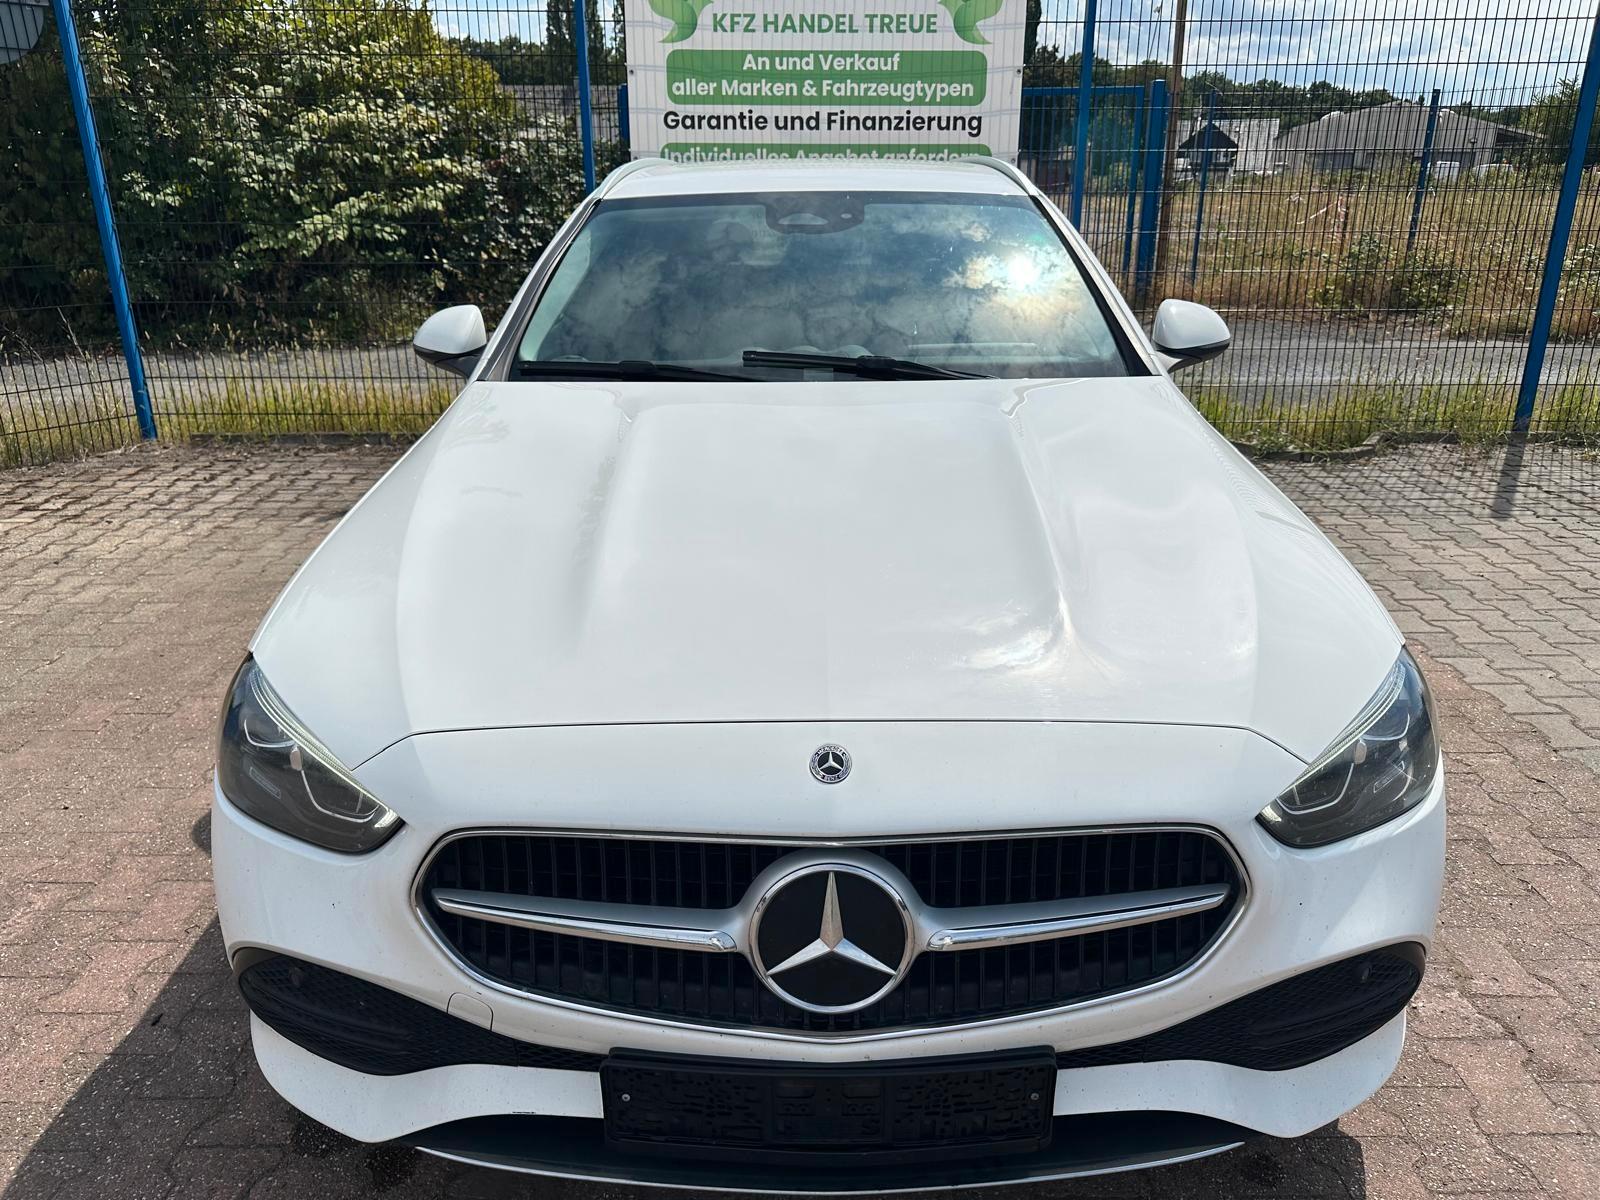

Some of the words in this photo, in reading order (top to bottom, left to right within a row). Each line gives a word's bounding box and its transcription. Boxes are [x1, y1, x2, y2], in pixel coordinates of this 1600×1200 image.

[712, 13, 756, 33] KFZ
[763, 13, 859, 34] HANDEL
[864, 13, 938, 34] TREUE
[742, 53, 770, 71] An
[775, 53, 814, 71] und
[819, 53, 900, 71] Verkauf
[671, 78, 717, 96] aller
[721, 79, 798, 96] Marken
[802, 79, 818, 97] &
[822, 79, 974, 102] Fahrzeugtypen
[663, 109, 768, 130] Garantie
[774, 111, 820, 131] und
[827, 109, 982, 138] Finanzierung
[664, 146, 788, 163] Individuelles
